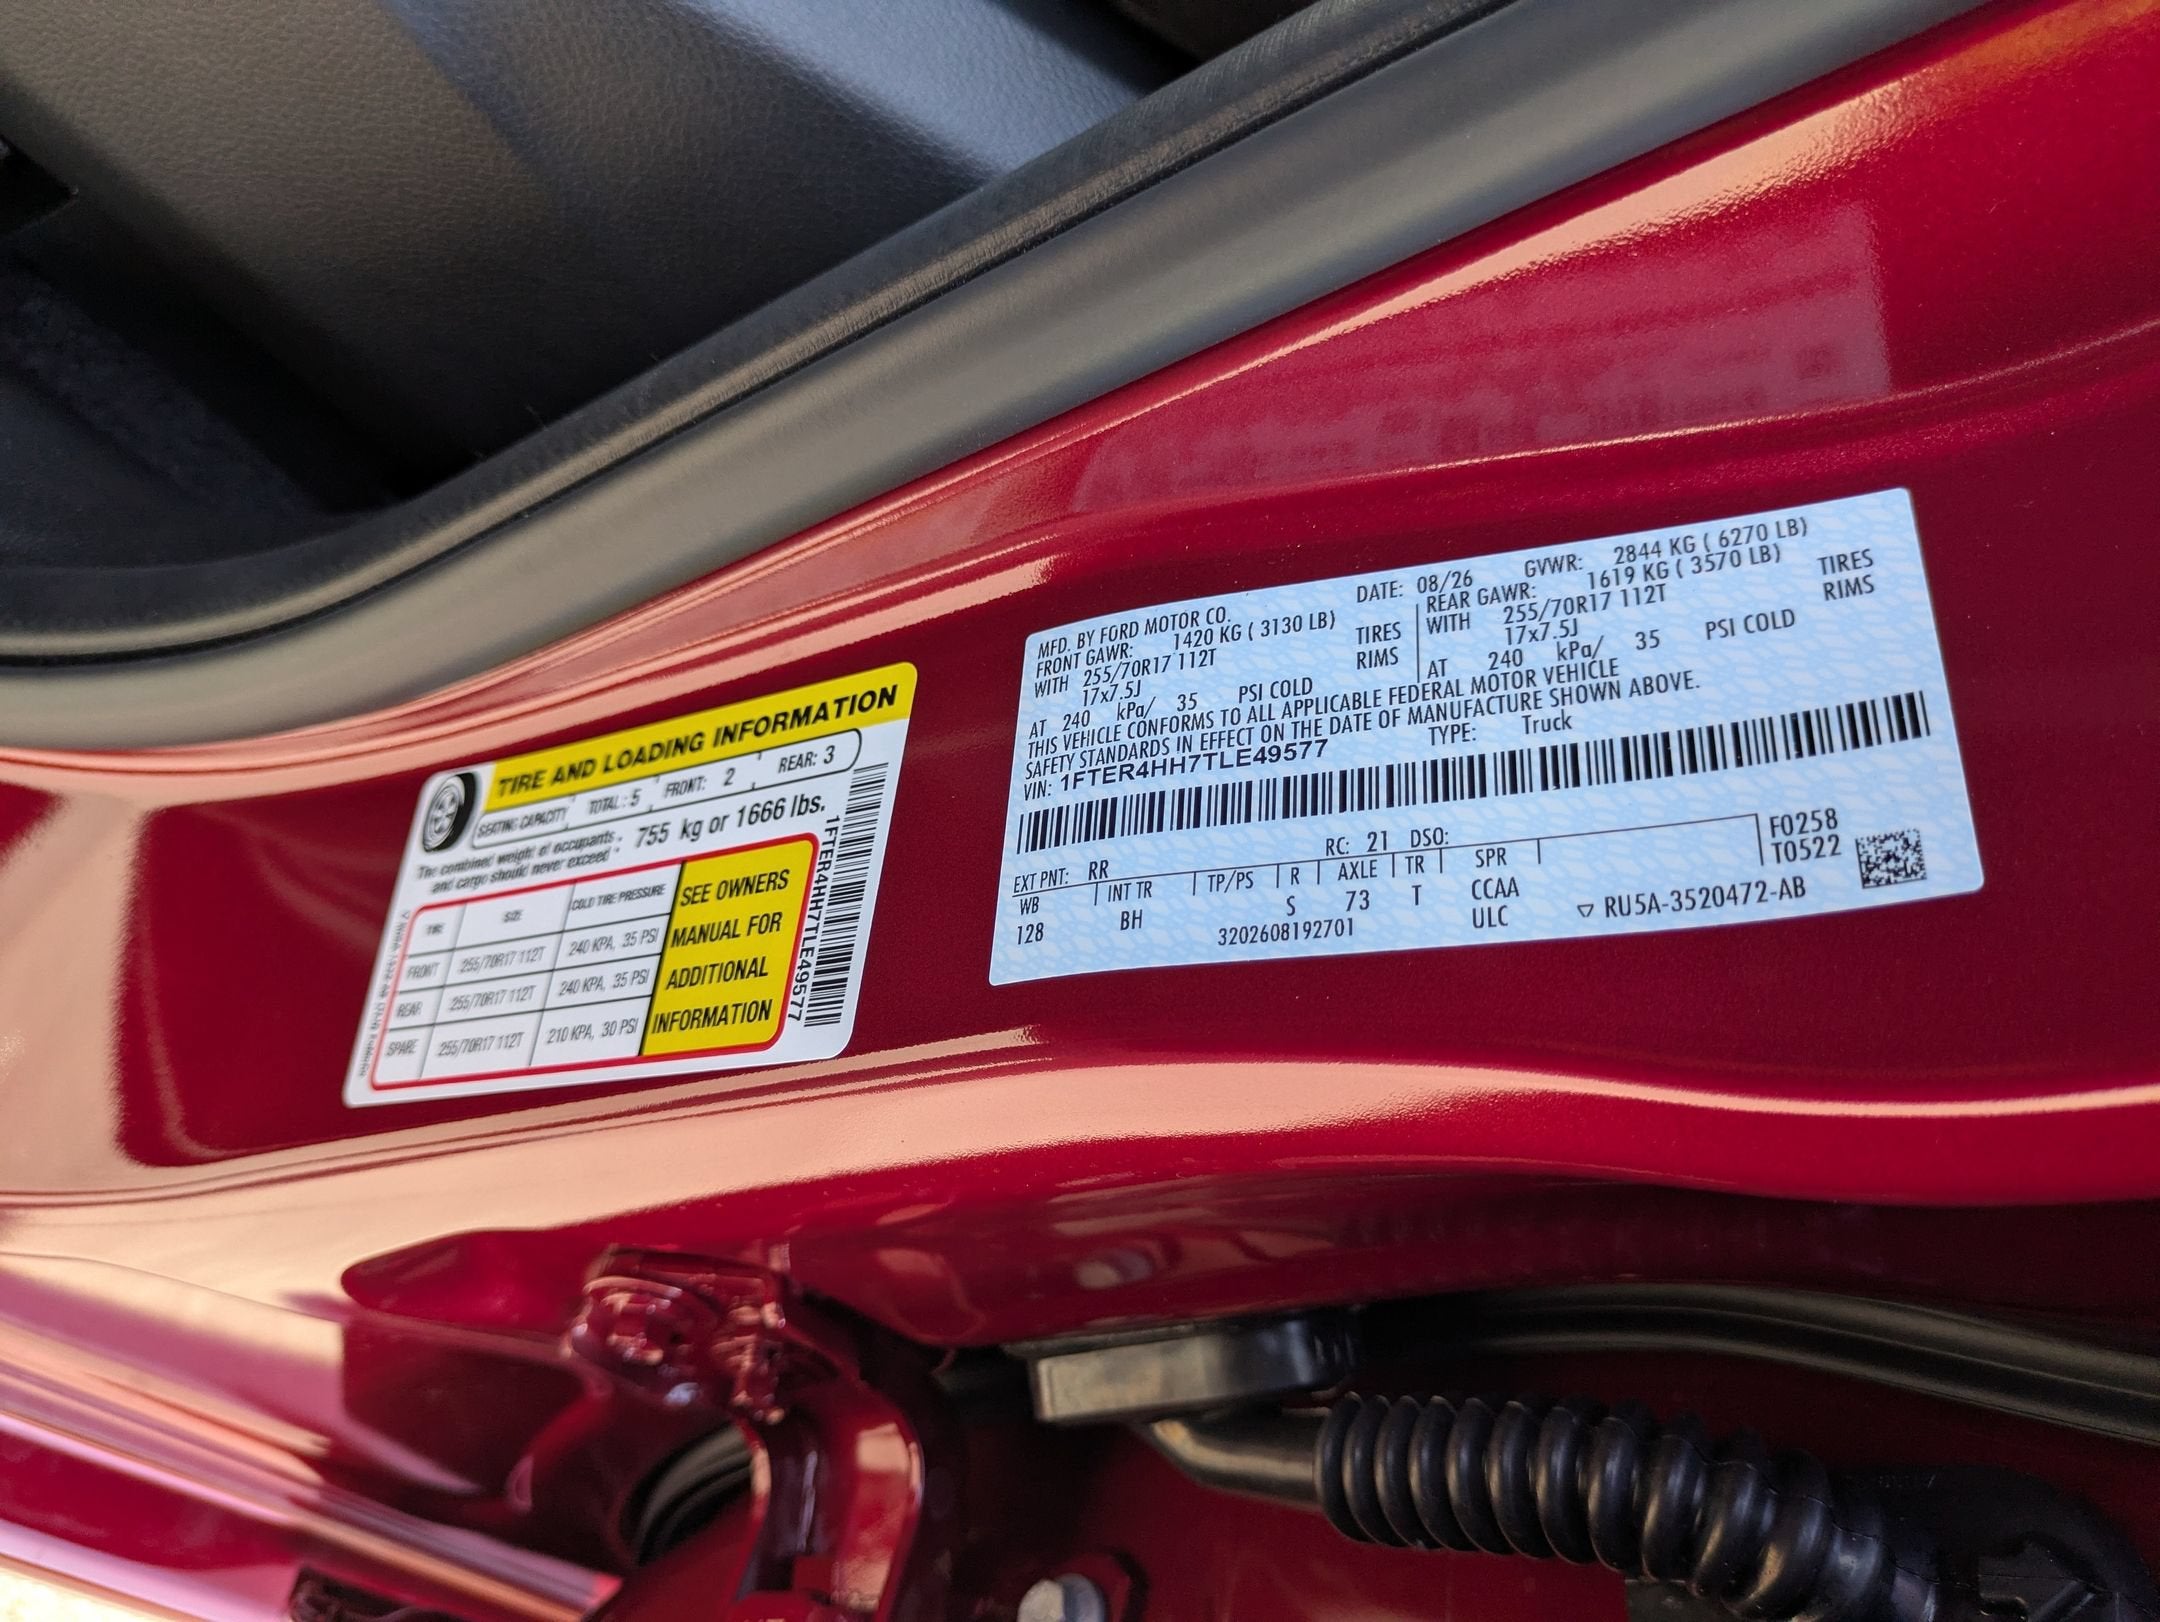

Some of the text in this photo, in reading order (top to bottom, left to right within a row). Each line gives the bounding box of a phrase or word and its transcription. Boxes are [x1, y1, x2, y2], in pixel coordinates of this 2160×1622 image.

[1524, 516, 1808, 577] GVWR: 2844 KG 6270 LB)
[1357, 569, 1473, 603] DATE: 08/26
[1426, 543, 1780, 613] REAR GAWR: 1619 KG 3570 LB)
[1426, 548, 1874, 635] WITH 255/70R17 112T TIRES
[1505, 575, 1874, 645] 17x7.5J RIMS
[1036, 610, 1335, 678] FRONT GAWR: 1420 KG 3130 LB)
[1038, 606, 1231, 659] MFD. BY FORD MOTOR CO.
[1427, 608, 1795, 679] AT 240 kPa/ 35 PSI COLD
[1034, 621, 1401, 698] WITH 255/70R17 112T TIRES
[1083, 647, 1398, 706] 17x7.5J RIMS
[1028, 658, 1619, 759] THIS VEHICLE CONFORMS TO ALL APPLICABLE FEDERAL MOTOR VEHICLE
[1029, 677, 1313, 739] AT 240 kPa/ 35 PSI COLD
[1025, 669, 1700, 779] SAFETY STANDARDS IN EFFECT ON THE DATE OF MANUFACTURE SHOWN ABOVE.
[1428, 708, 1572, 746] TYPE: Truck
[499, 684, 897, 797] TIRE AND LOADING INFORMATION
[777, 745, 835, 773] REAR: 3
[1024, 738, 1329, 800] VIN: 1FTER4HH7TLE49577
[631, 789, 642, 807] 5
[664, 768, 736, 798] FRONT: 2
[477, 806, 570, 838] SEATING CAPACITY
[635, 794, 825, 849] 755 kg or 1666 lbs.
[1769, 807, 1838, 838] F0258
[1325, 831, 1388, 857] RC: 21
[1410, 827, 1449, 848] DSO:
[1771, 834, 1841, 864] T0522
[417, 829, 616, 880] The combined weight occupants
[1405, 855, 1424, 874] TR
[1475, 847, 1507, 868] SPR
[432, 849, 610, 894] and cargo should never exceed
[1013, 859, 1109, 894] EXT PNT: RR
[1208, 869, 1254, 893] TP/PS
[1290, 866, 1300, 885] R
[1338, 859, 1378, 881] AXLE
[571, 884, 666, 911] COLD TIRE PRESSURE
[681, 869, 790, 907] SEE OWNERS
[1107, 880, 1153, 902] INT TR
[1345, 889, 1370, 912] 73
[1411, 884, 1422, 905] T
[1471, 876, 1520, 900] CCAA
[1604, 875, 1806, 918] RU5A-3520472-AB
[788, 814, 841, 1022] 1FTER4HH7TLE49577
[1020, 896, 1039, 915] WB
[1120, 909, 1143, 930] BH
[1286, 895, 1296, 916] S
[1472, 905, 1508, 928] ULC
[569, 928, 660, 956] 240 KPA, 35 PSI
[670, 911, 783, 948] MANUAL FOR
[1017, 922, 1044, 944] 128
[1218, 917, 1353, 946] 3202608192701
[519, 946, 546, 962] 112T
[407, 962, 440, 979] FRONT
[559, 969, 650, 996] 240 KPA, 35 PSI
[665, 956, 769, 991] ADDITIONAL
[509, 985, 536, 1001] 112T
[397, 1001, 423, 1018] REAR
[652, 999, 773, 1034] INFORMATION
[497, 1032, 524, 1048] 112T
[547, 1018, 639, 1044] 210 KPA, 30 PSI
[386, 1039, 419, 1057] SPARE
